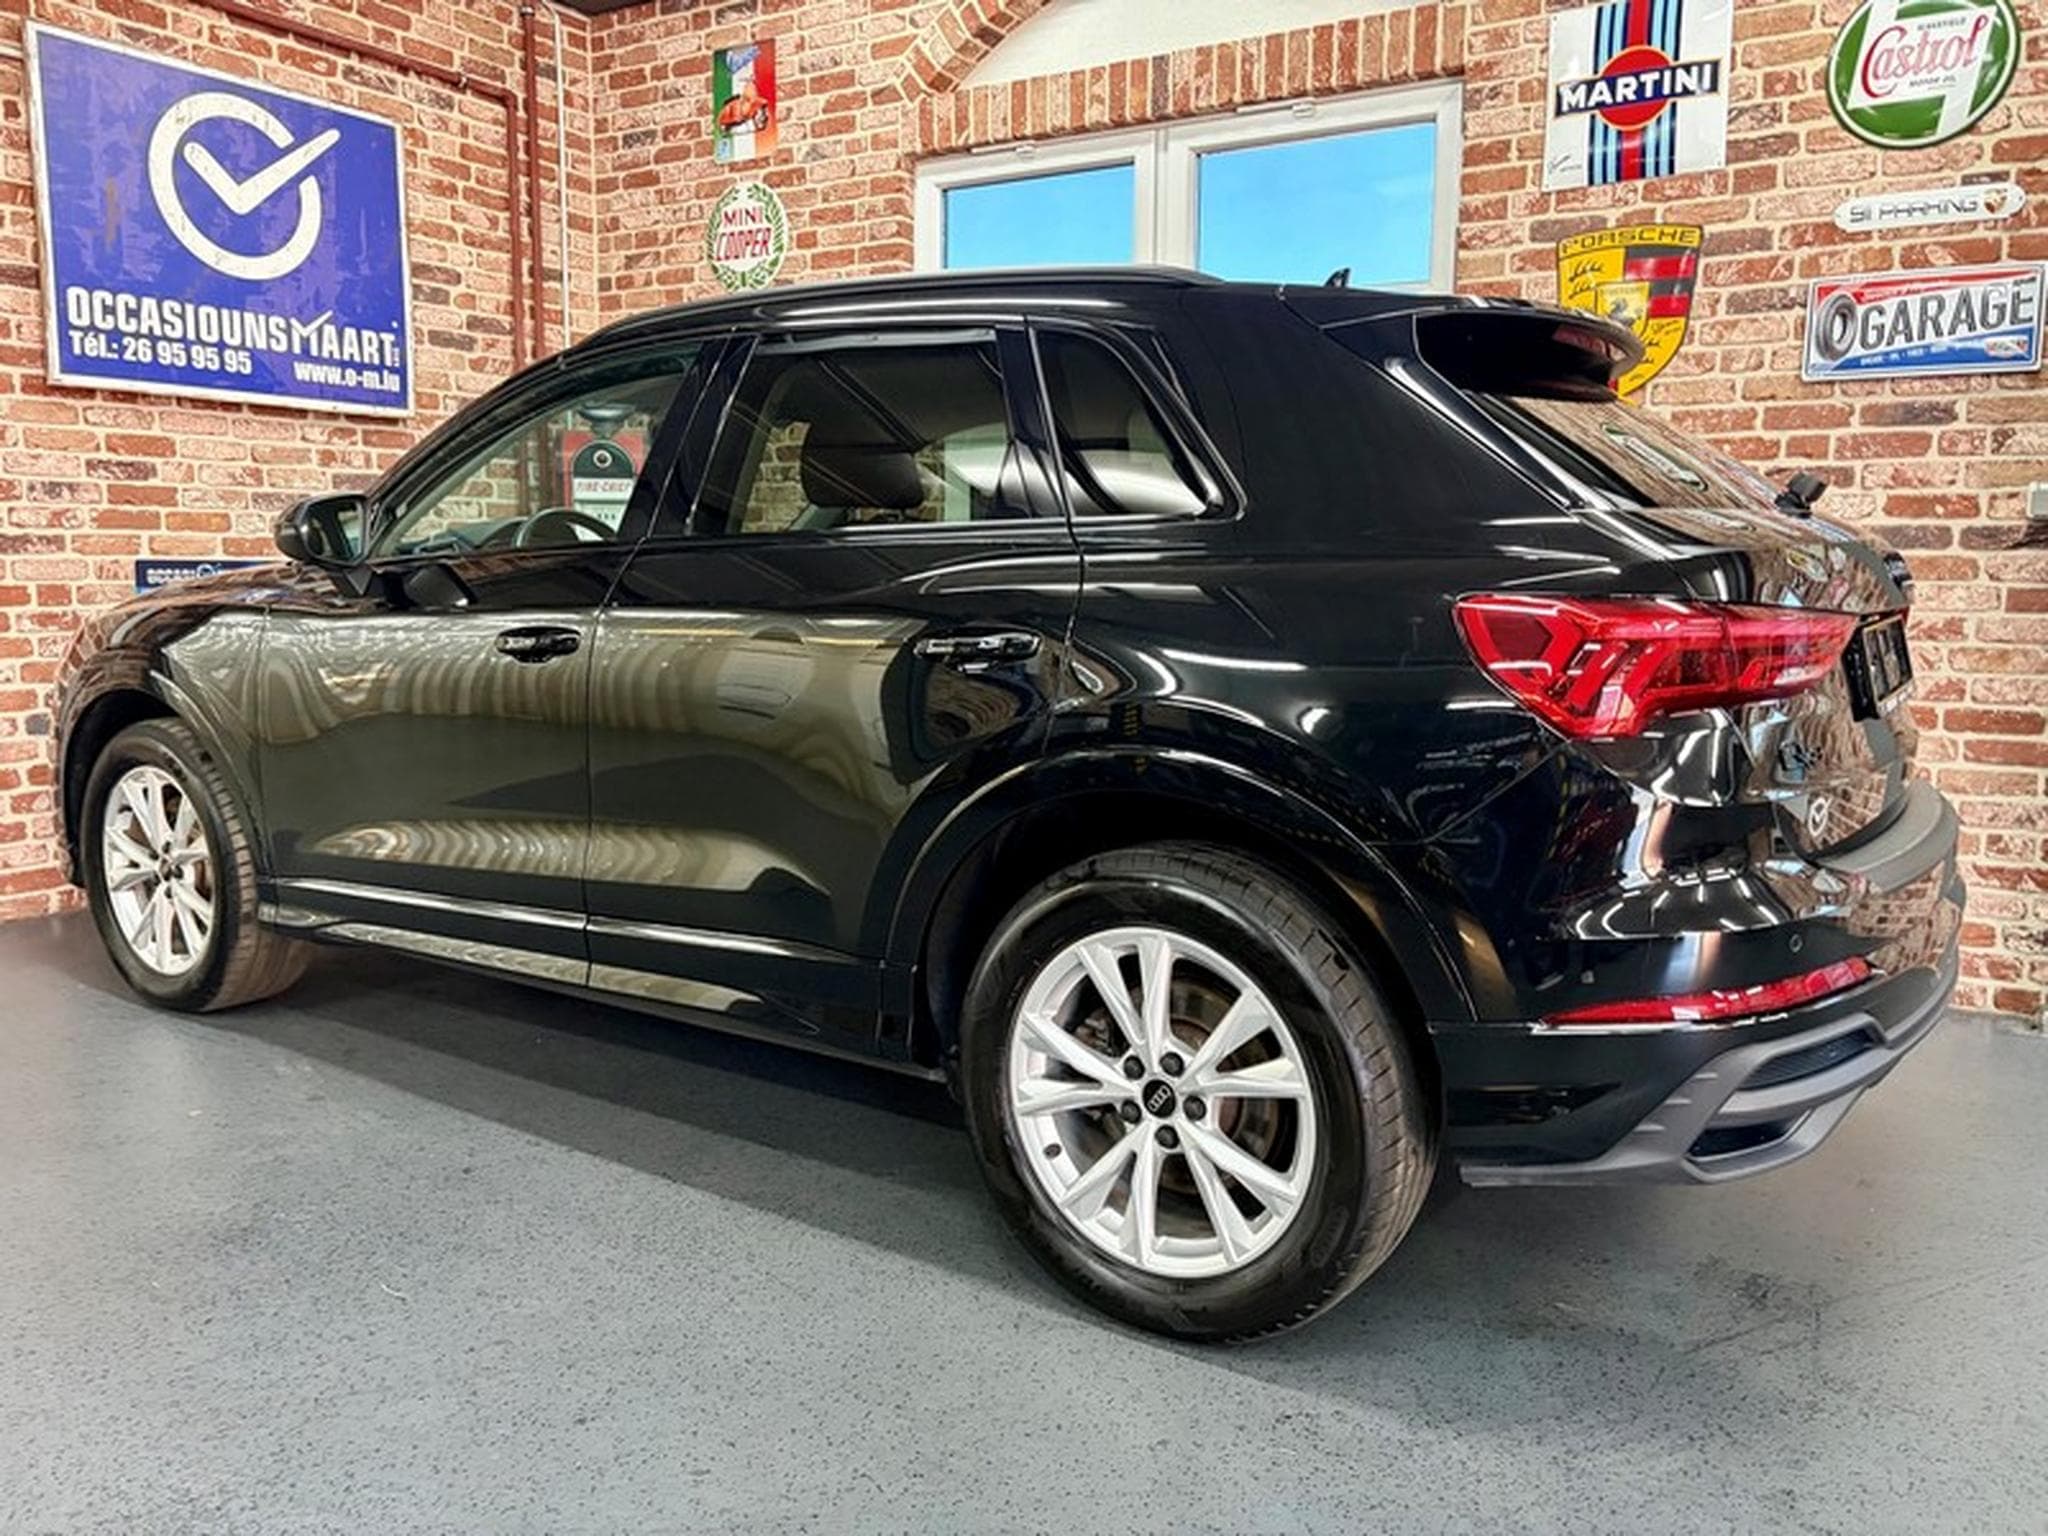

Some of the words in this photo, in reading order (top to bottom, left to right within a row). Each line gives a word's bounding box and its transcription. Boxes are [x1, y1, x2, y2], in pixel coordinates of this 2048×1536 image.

[1861, 14, 1989, 98] Castrol
[1559, 64, 1712, 113] MARTINI
[723, 206, 764, 228] MINI
[715, 227, 772, 261] COOPER
[1562, 228, 1697, 254] PORSCHE
[1859, 277, 2037, 351] GARAGE
[122, 335, 153, 364] 26
[156, 341, 188, 368] 95
[191, 346, 221, 372] 95
[224, 349, 253, 376] 95
